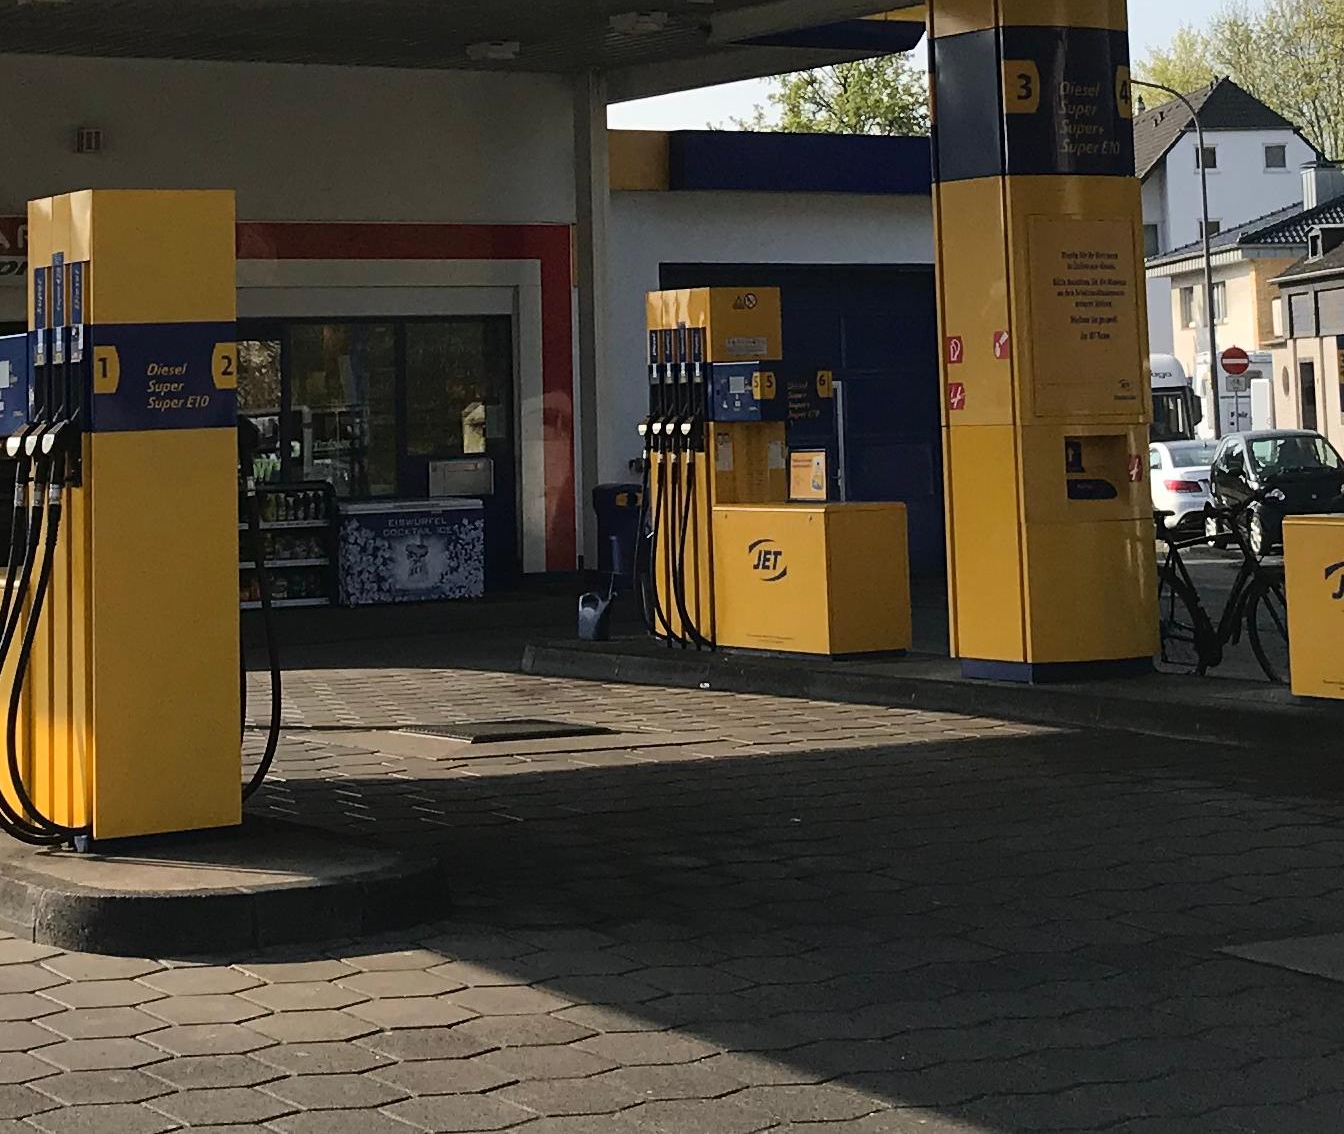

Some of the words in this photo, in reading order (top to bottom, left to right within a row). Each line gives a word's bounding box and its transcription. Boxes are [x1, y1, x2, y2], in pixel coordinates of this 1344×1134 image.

[1017, 73, 1032, 100] 3
[1059, 82, 1100, 98] Diesel
[1119, 79, 1130, 104] 4
[1059, 100, 1098, 119] Super
[1059, 138, 1099, 158] Super
[98, 357, 108, 379] 1
[146, 362, 188, 377] Diesel
[221, 355, 234, 376] 2
[146, 379, 184, 396] Super
[766, 375, 773, 388] 5
[819, 374, 826, 387] 6
[146, 395, 184, 412] Super
[186, 395, 210, 409] E10
[752, 549, 783, 571] JET
